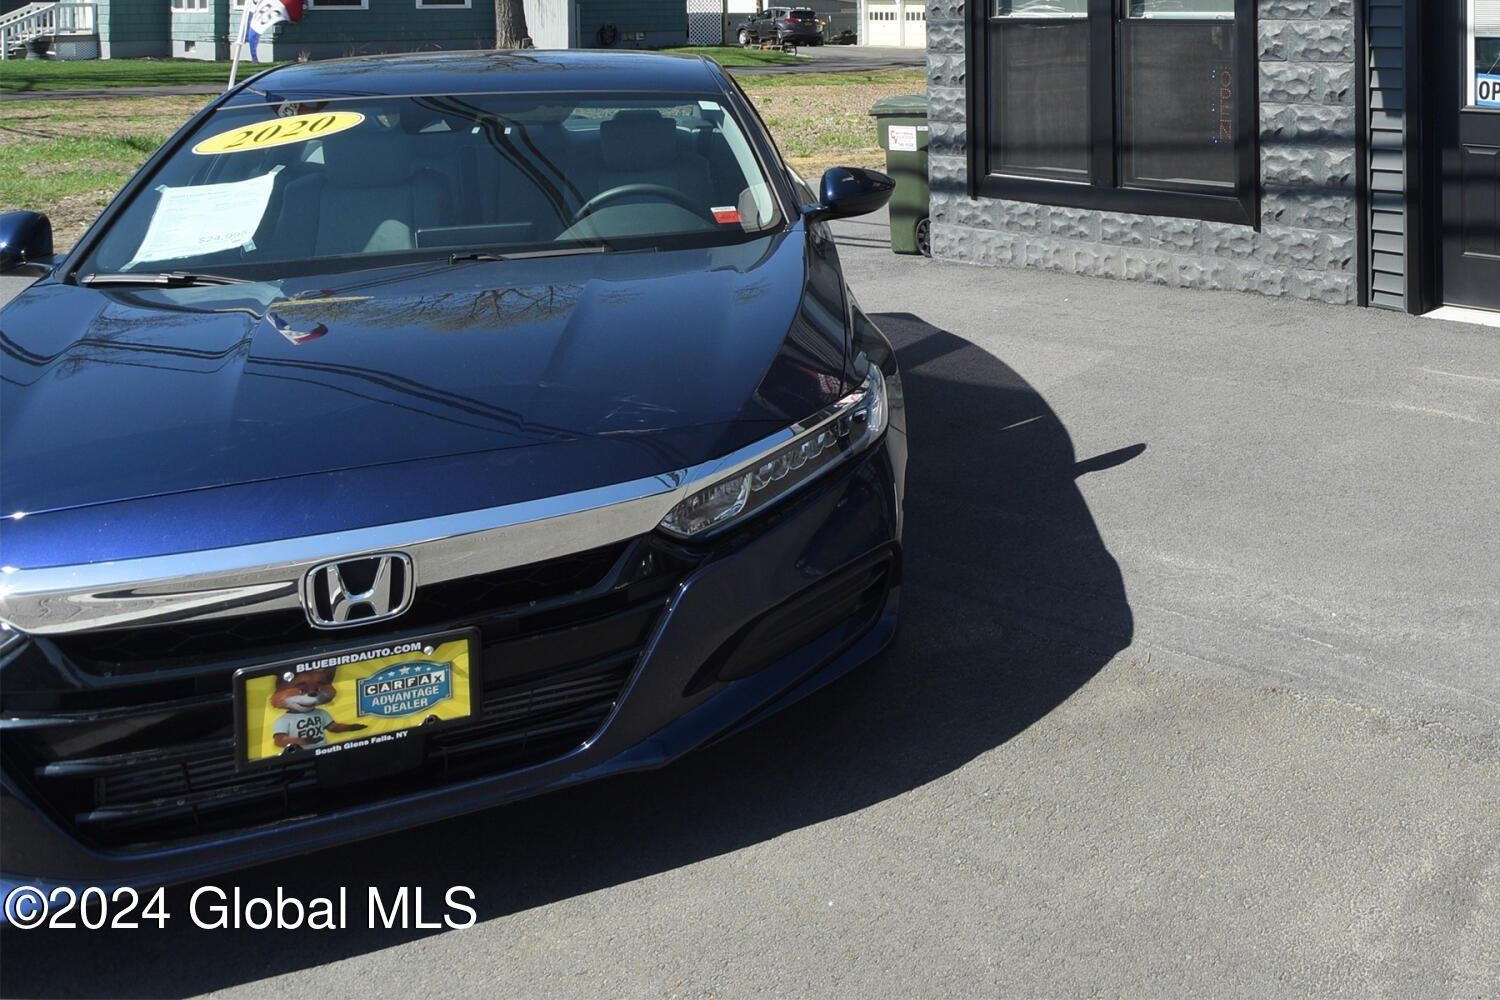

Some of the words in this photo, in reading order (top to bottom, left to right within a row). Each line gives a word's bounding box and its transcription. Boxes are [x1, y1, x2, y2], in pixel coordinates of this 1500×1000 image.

[224, 115, 336, 149] 2020
[296, 642, 422, 673] BLUEBIRDAUTO.COM
[366, 673, 444, 695] CARFAX
[371, 685, 440, 707] ADVANTAGE
[384, 698, 429, 715] DEALER
[296, 716, 322, 730] CAR
[298, 726, 323, 739] FOX
[315, 744, 342, 756] South
[396, 731, 409, 739] NY
